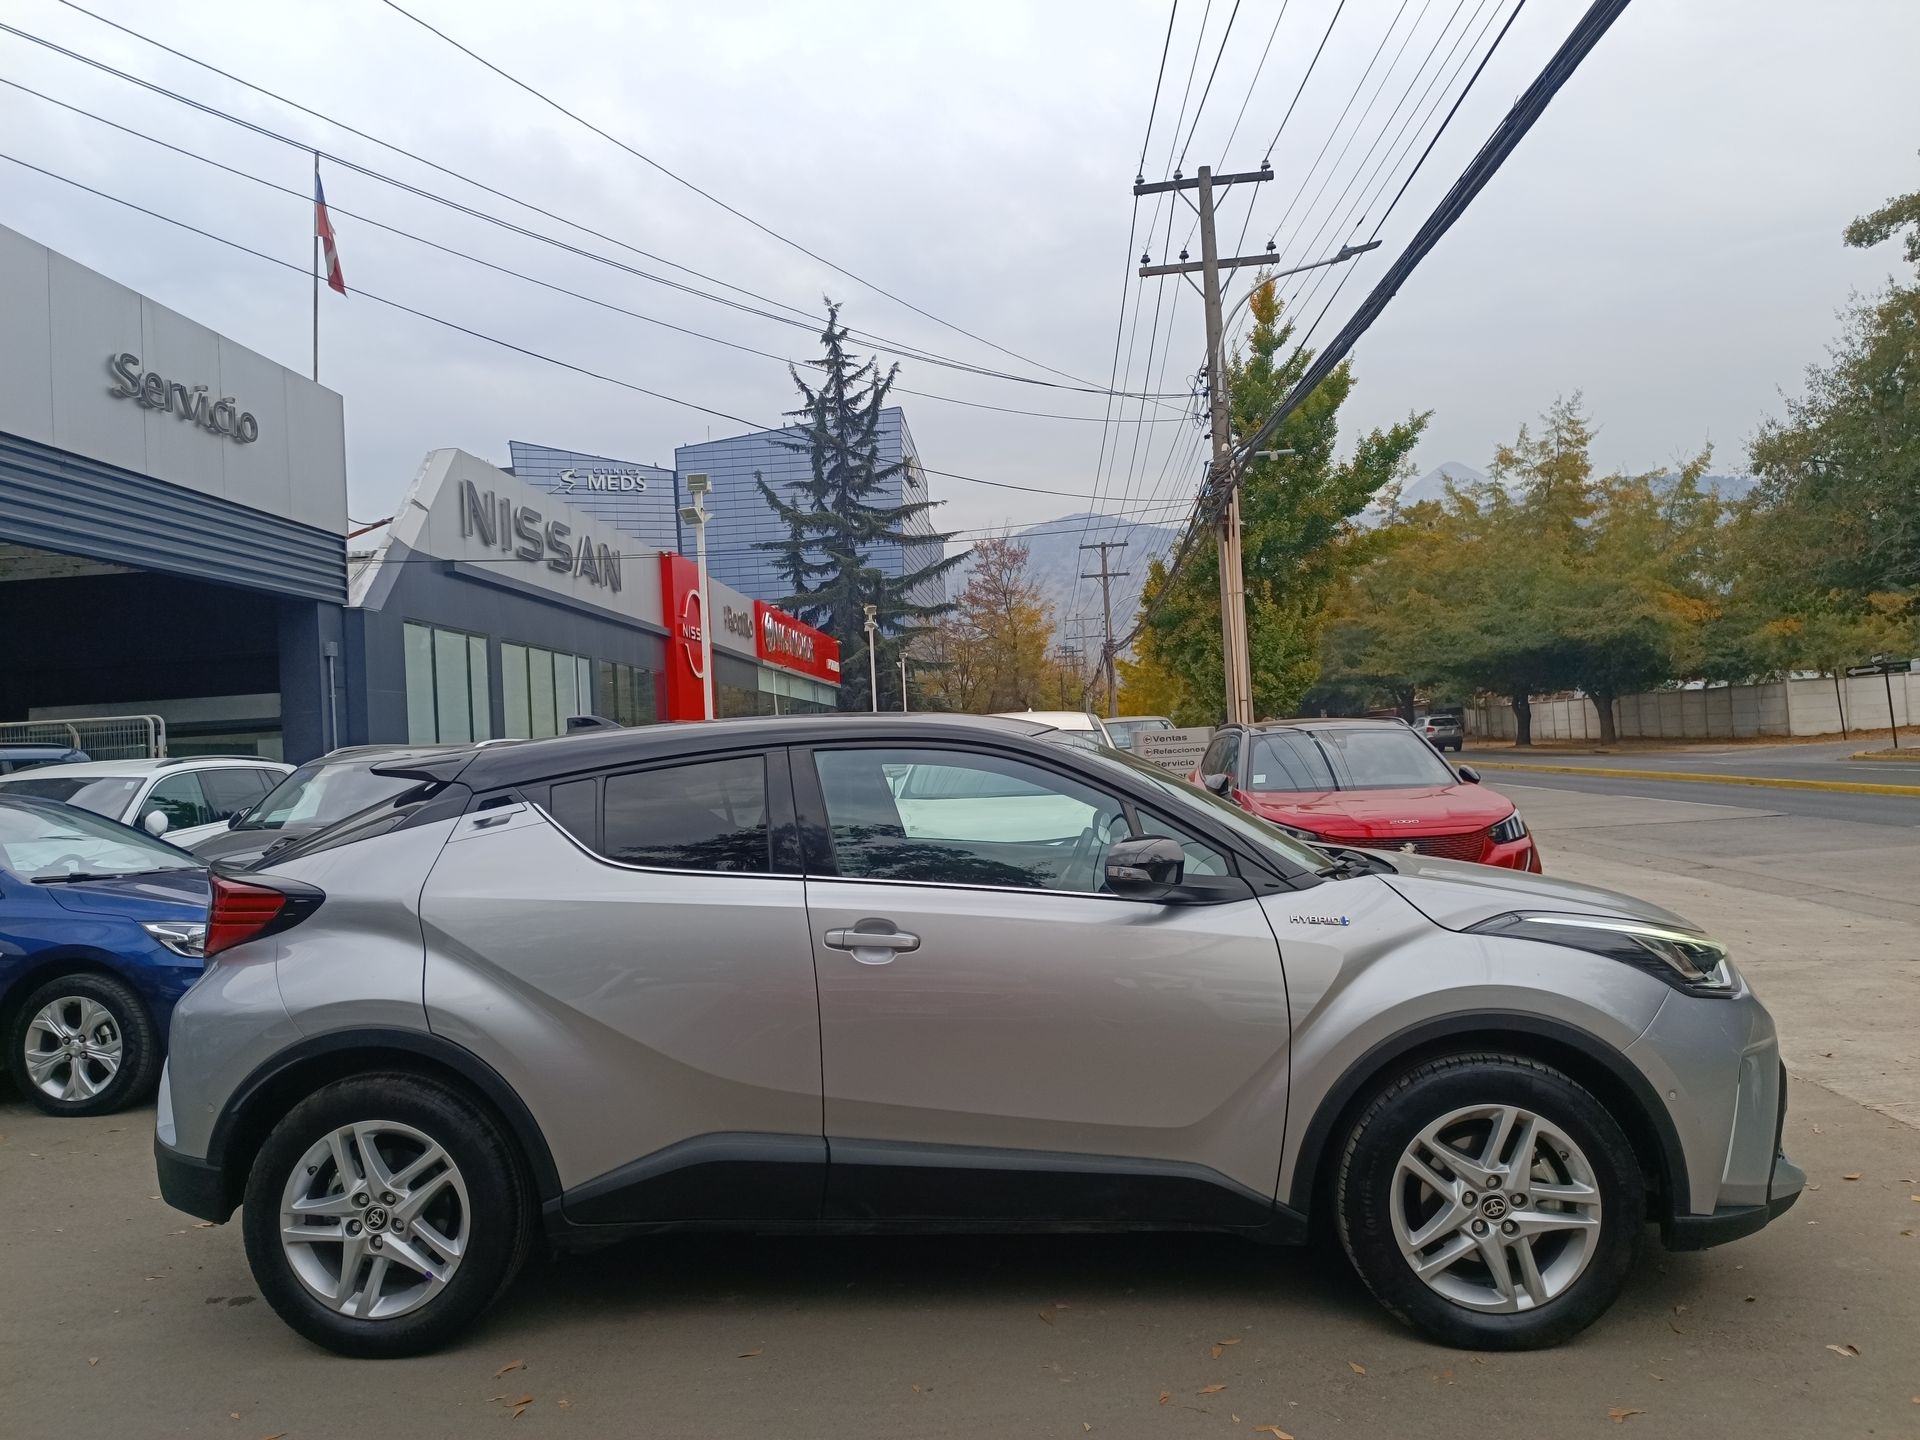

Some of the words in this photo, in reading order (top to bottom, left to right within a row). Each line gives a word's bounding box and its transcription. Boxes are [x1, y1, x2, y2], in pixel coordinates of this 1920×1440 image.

[108, 352, 259, 444] Servicio
[587, 474, 647, 492] MEDS
[460, 478, 622, 593] NISSAN
[682, 623, 701, 641] NISS
[1153, 735, 1188, 743] Ventas
[1153, 746, 1206, 755] Refacciones
[1154, 760, 1195, 768] Servicio
[1289, 914, 1340, 926] HYBRID
